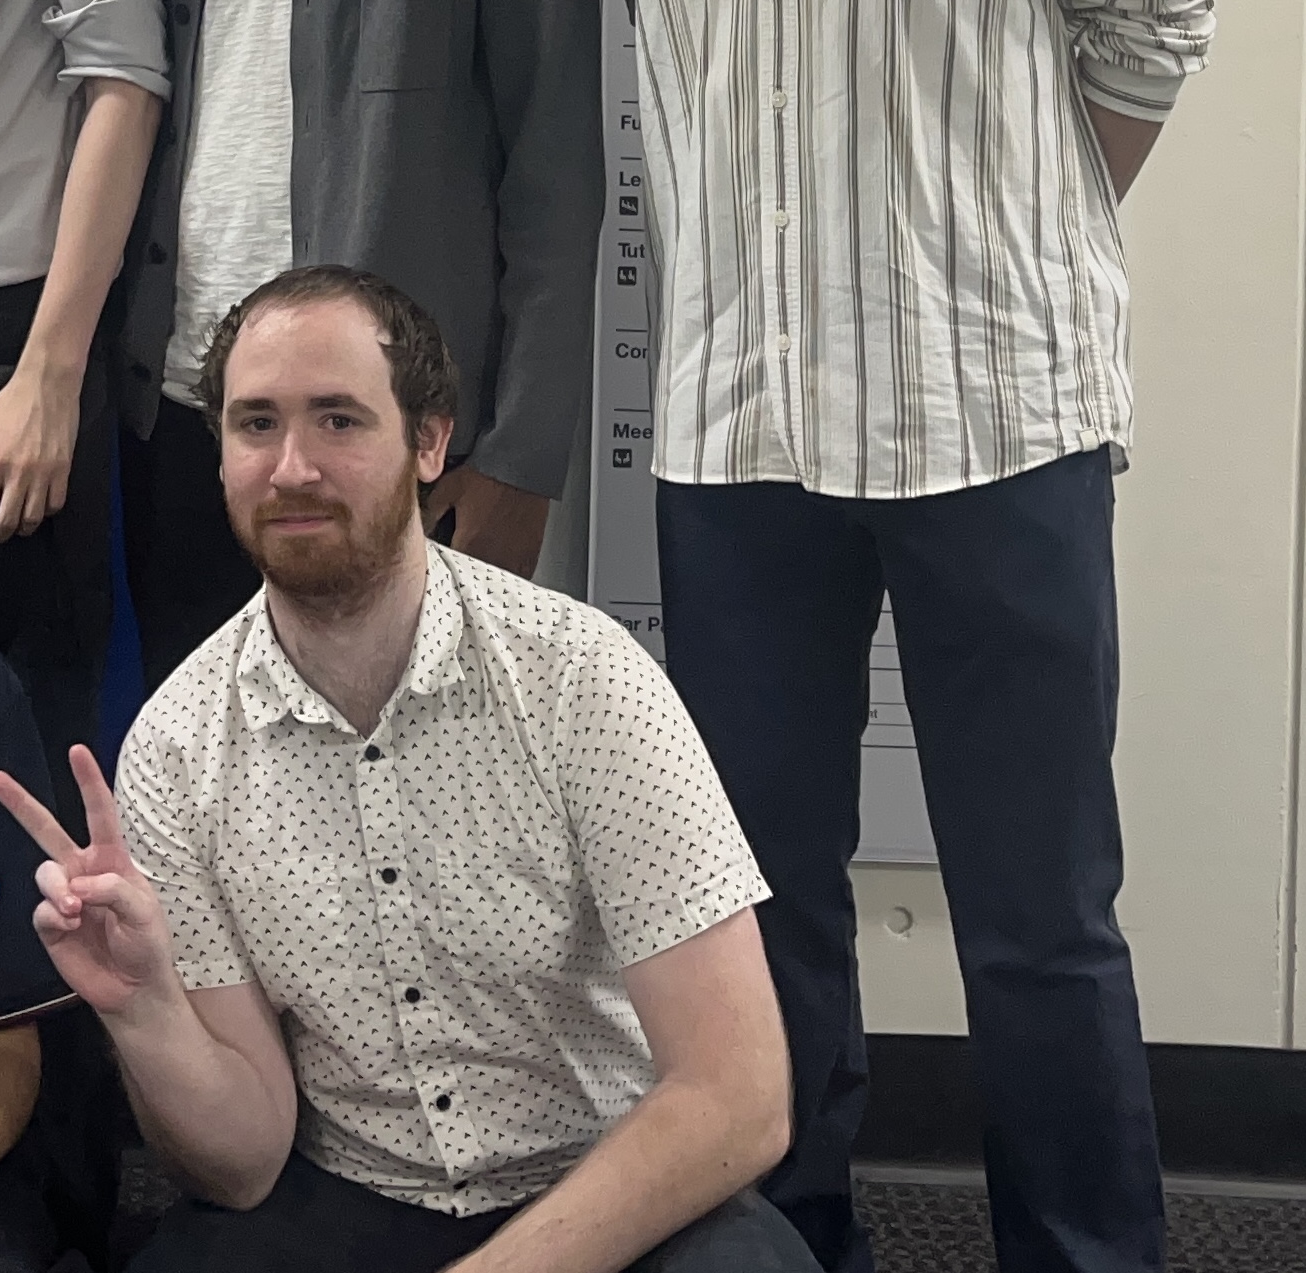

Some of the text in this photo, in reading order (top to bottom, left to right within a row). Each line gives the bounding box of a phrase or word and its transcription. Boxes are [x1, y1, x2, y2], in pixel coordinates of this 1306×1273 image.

[619, 171, 641, 186] Le
[618, 241, 645, 258] Tut
[613, 423, 653, 438] Mee
